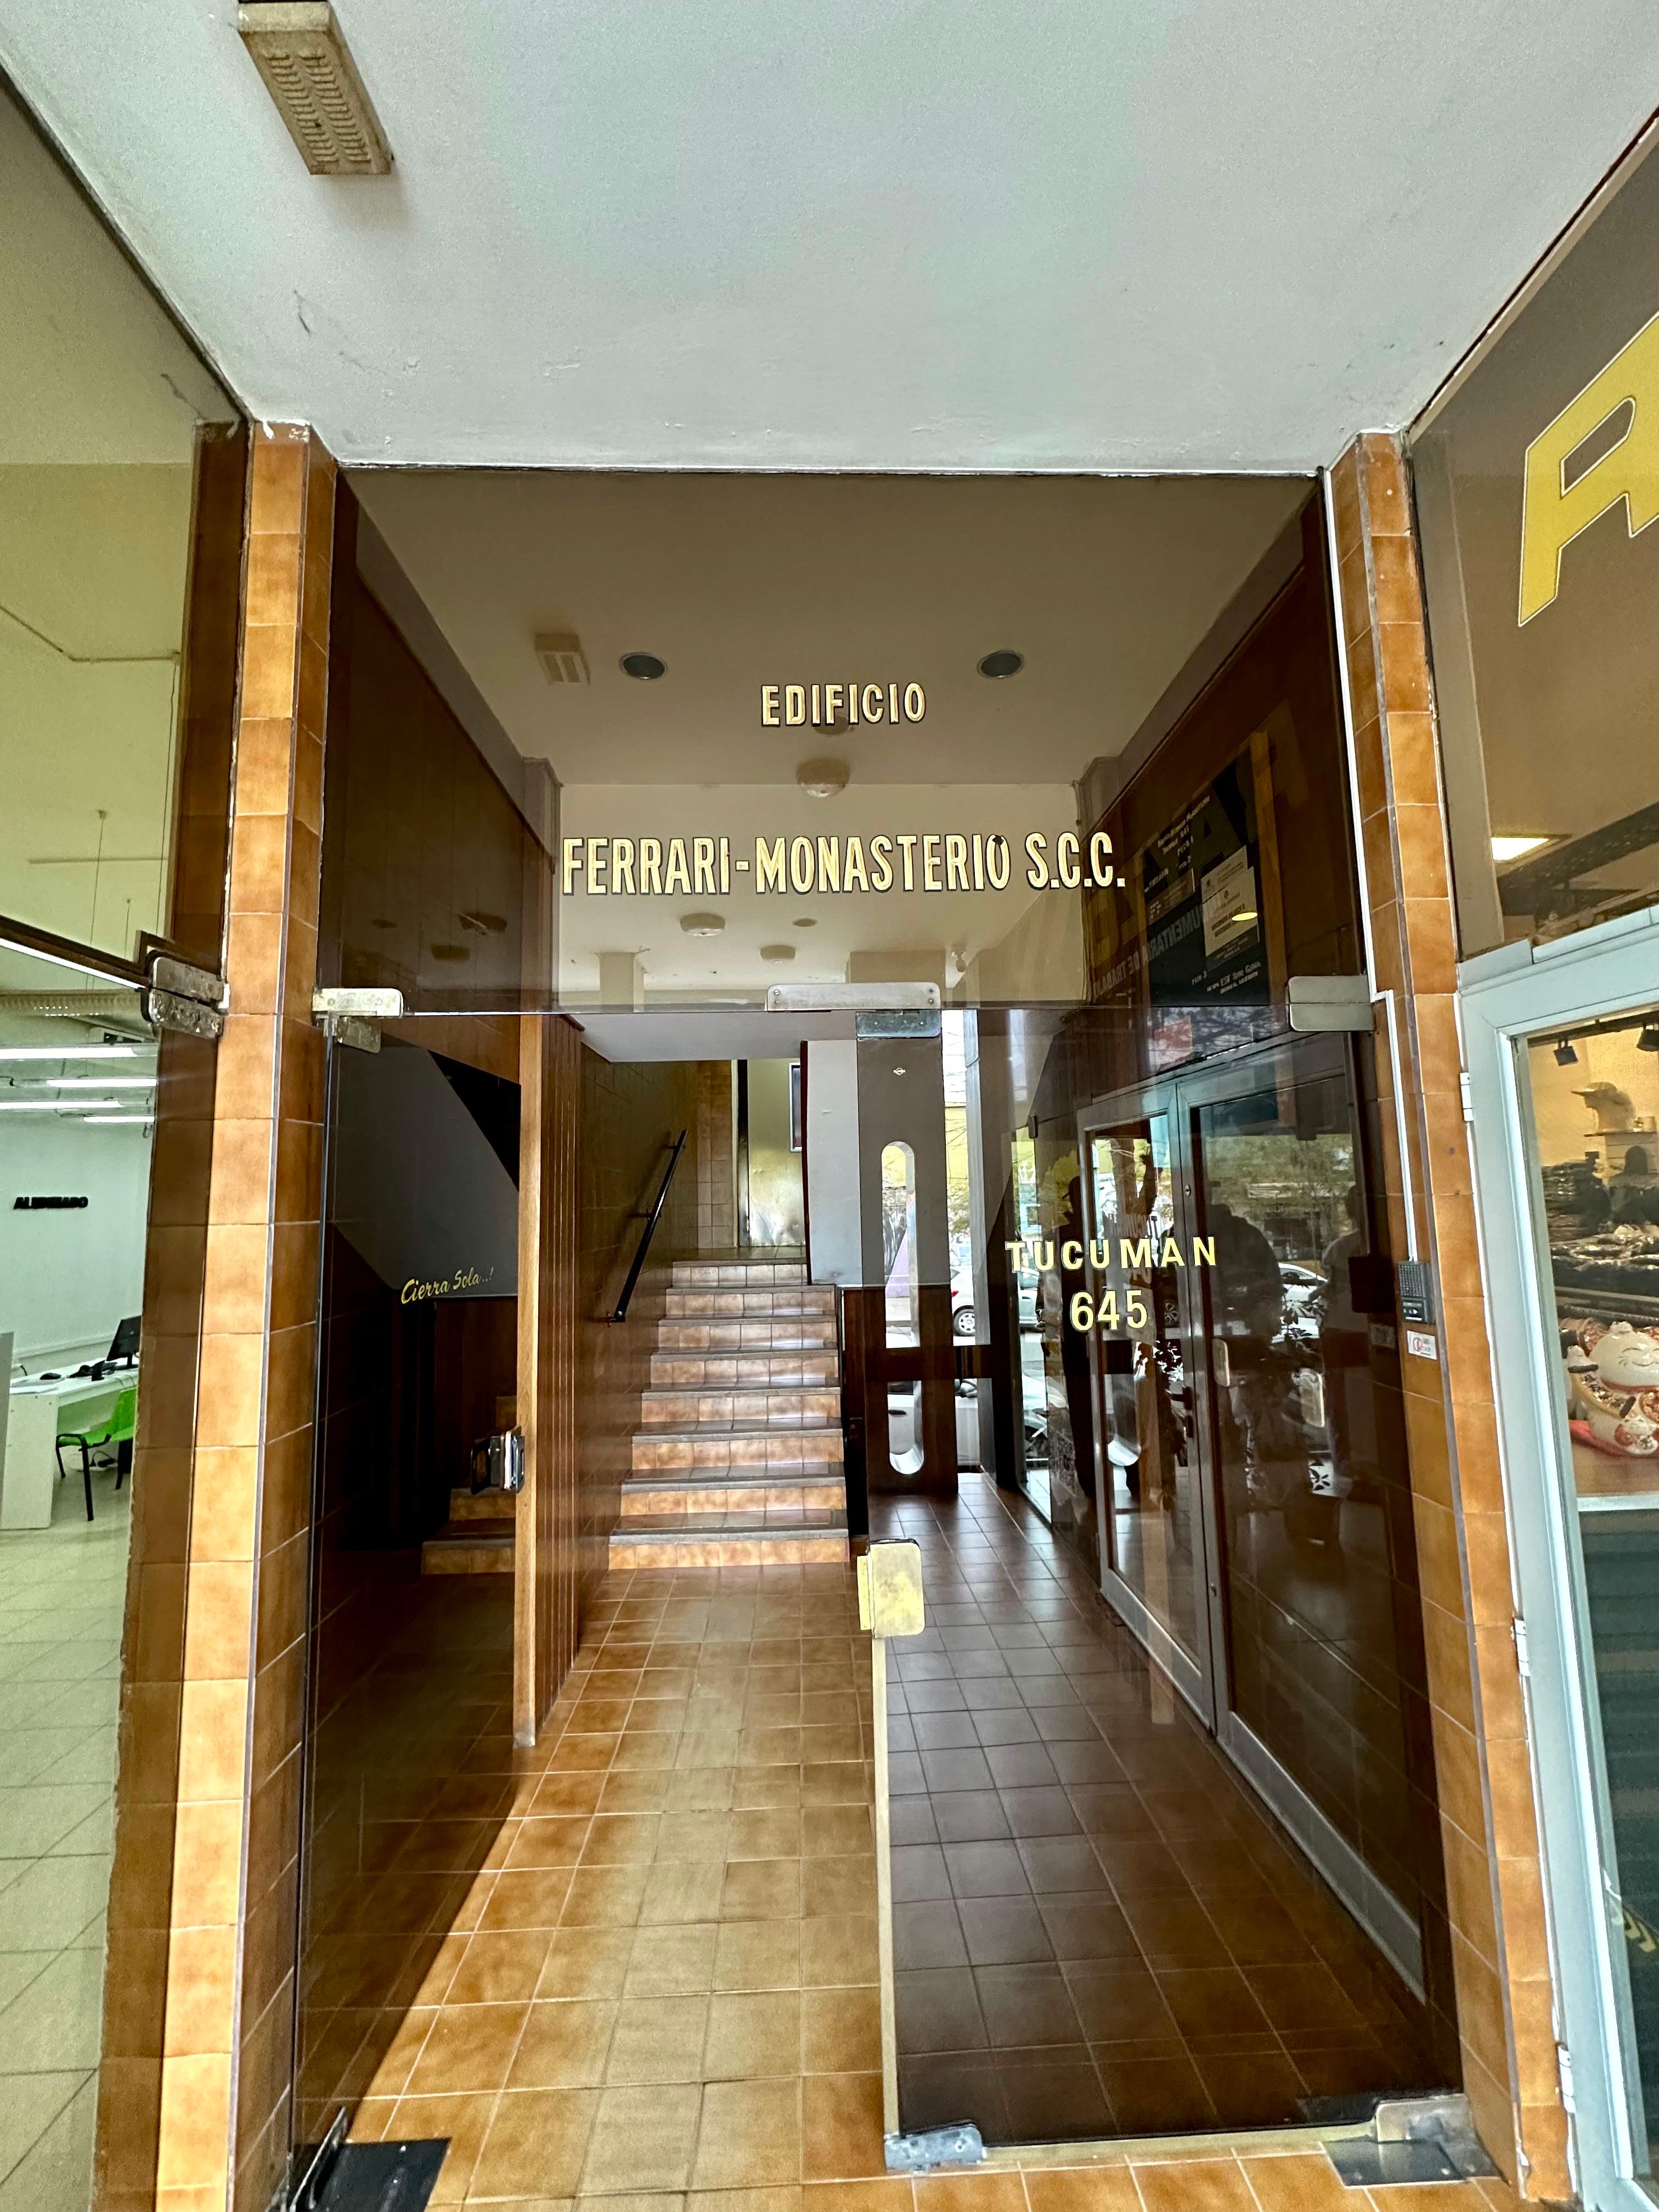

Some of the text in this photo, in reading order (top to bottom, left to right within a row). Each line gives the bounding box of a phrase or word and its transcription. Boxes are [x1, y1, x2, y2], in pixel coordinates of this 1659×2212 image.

[761, 682, 926, 726] EDIFICIO
[562, 833, 1011, 895] FERRARI-MONASTERIO
[1024, 832, 1126, 890] S.C.C.
[1005, 1236, 1217, 1273] TUCUMAN
[401, 1278, 450, 1304] Cierra
[1070, 1289, 1148, 1333] 645
